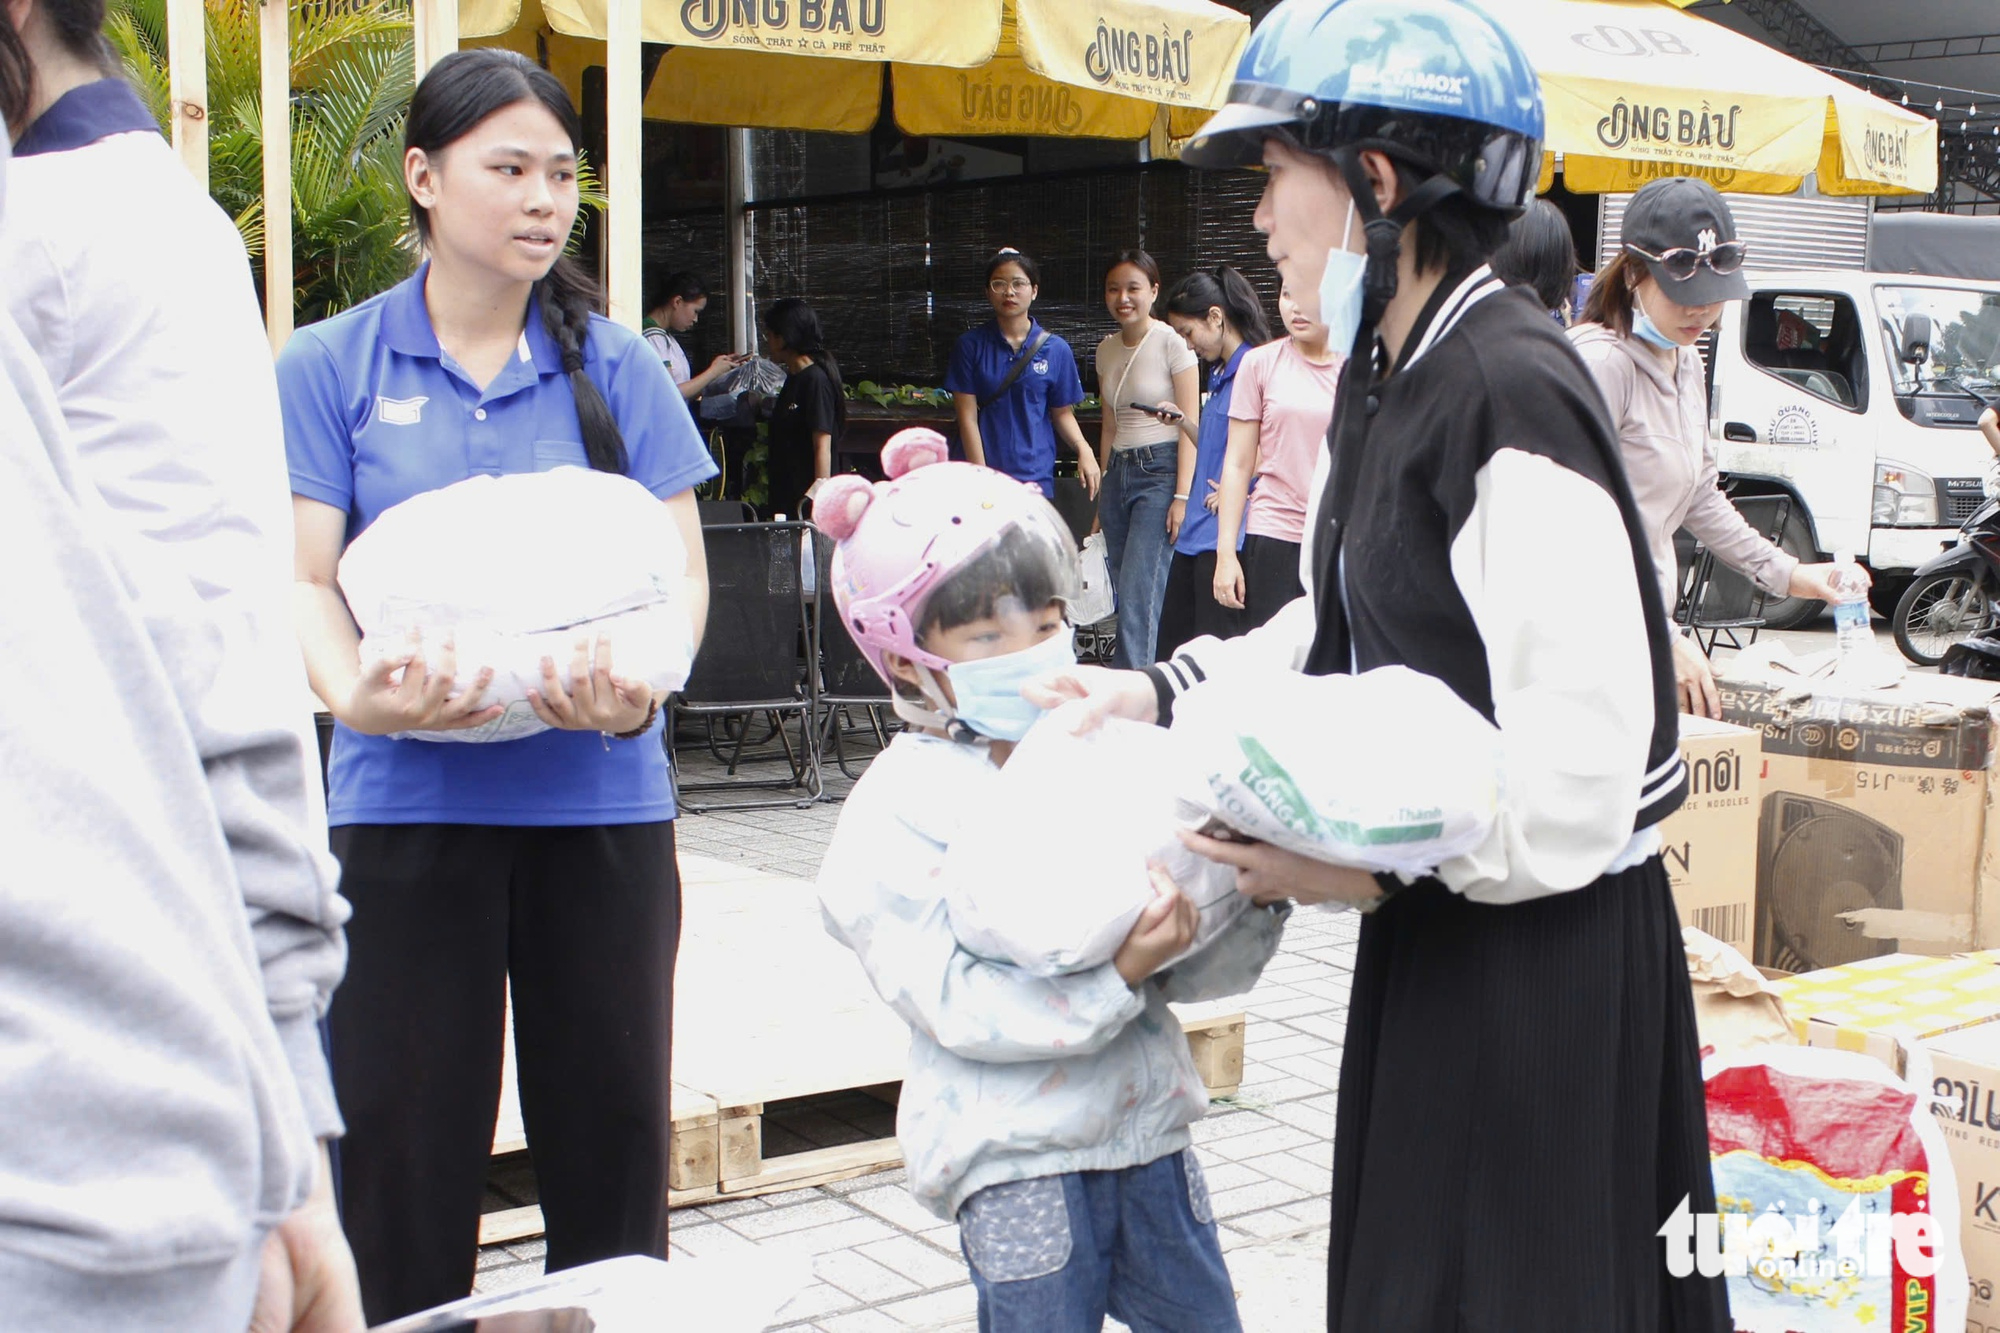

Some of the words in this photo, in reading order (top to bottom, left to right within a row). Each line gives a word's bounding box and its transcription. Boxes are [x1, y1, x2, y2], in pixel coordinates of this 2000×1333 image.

[812, 39, 826, 49] CÀ
[832, 41, 852, 51] PHÊ
[1085, 17, 1142, 84] ÔNG
[1597, 96, 1671, 149] ÔNG
[1678, 100, 1742, 150] BẦU
[1856, 771, 1895, 791] J15
[1707, 797, 1749, 808] NOODLES
[1904, 1278, 1929, 1333] VIP
